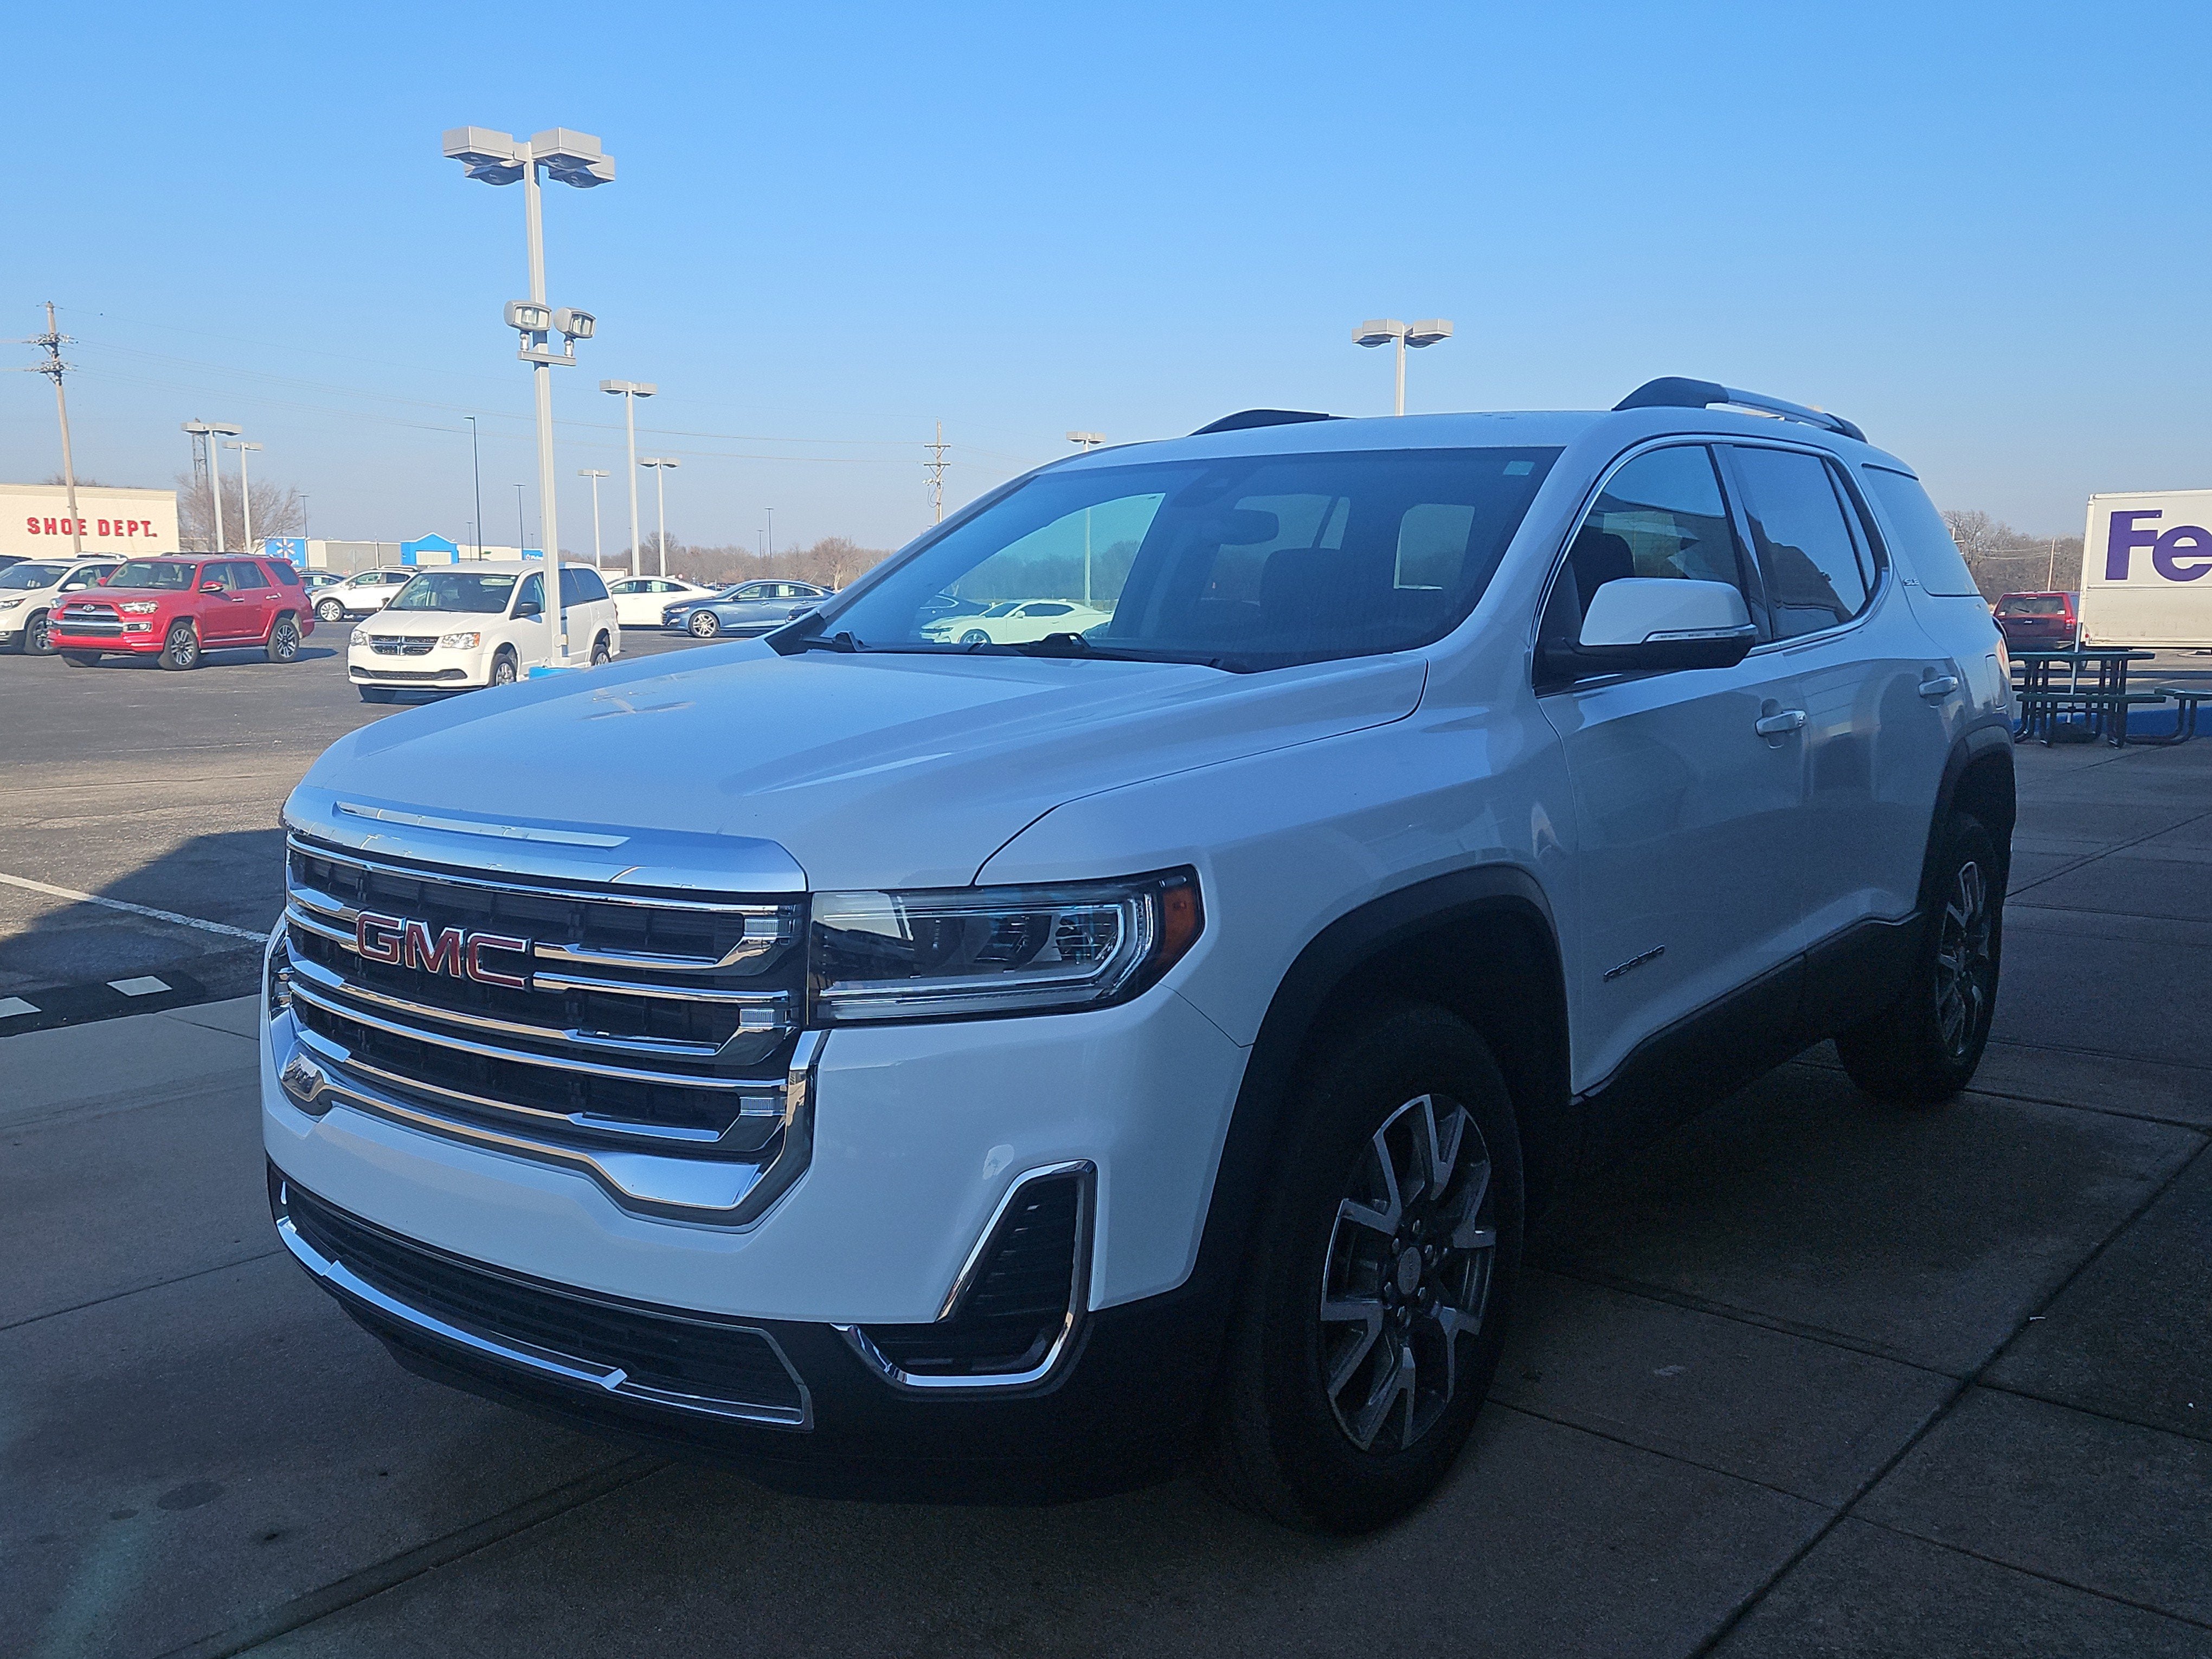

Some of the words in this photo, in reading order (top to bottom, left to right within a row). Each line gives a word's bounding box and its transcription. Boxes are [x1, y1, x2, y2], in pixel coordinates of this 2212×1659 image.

[27, 517, 88, 536] SHOE
[98, 519, 158, 537] DEPT.
[357, 910, 531, 992] GMC
